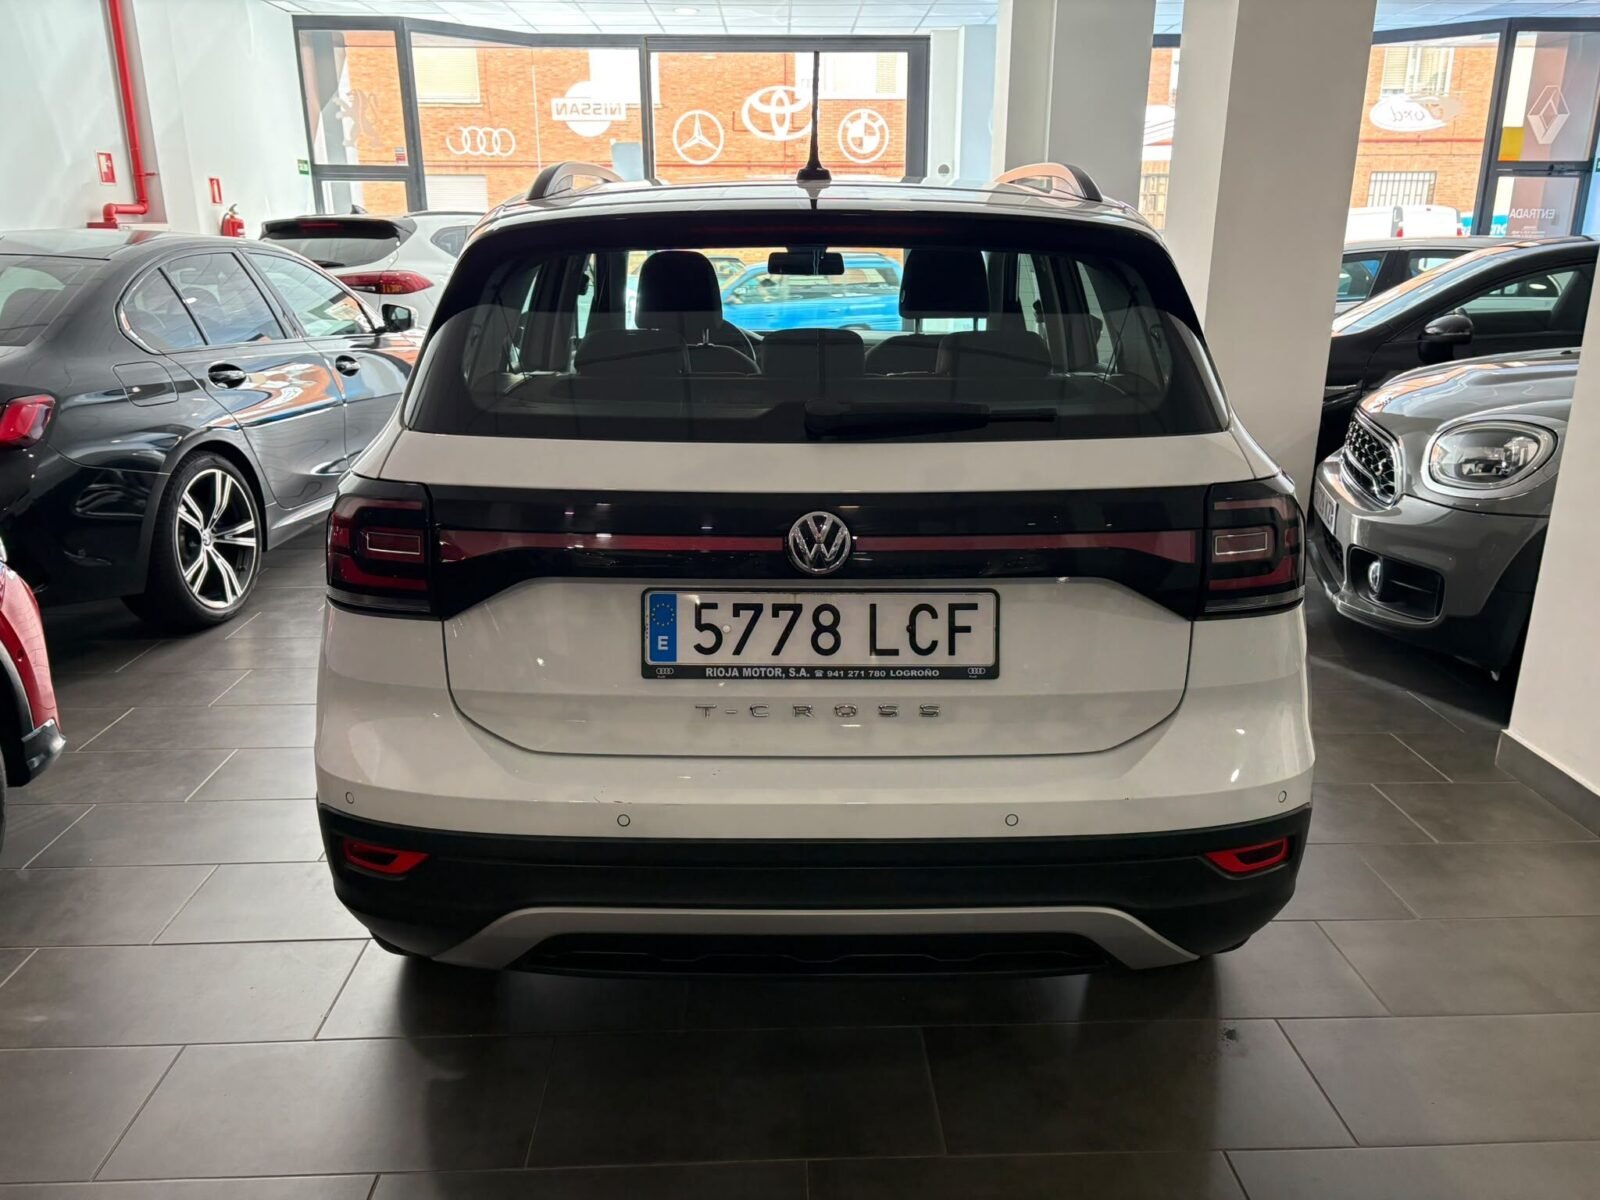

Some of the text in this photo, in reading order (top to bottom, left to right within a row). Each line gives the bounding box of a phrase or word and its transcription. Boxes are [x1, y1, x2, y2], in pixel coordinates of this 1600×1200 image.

[694, 603, 842, 656] 5778
[869, 603, 978, 656] LCF
[657, 635, 669, 650] E
[705, 667, 739, 677] RIOJA
[742, 667, 786, 679] MOTOR,
[788, 667, 810, 677] S.A.
[890, 668, 940, 677] LOGROÑO
[695, 704, 941, 718] T-CROSS
